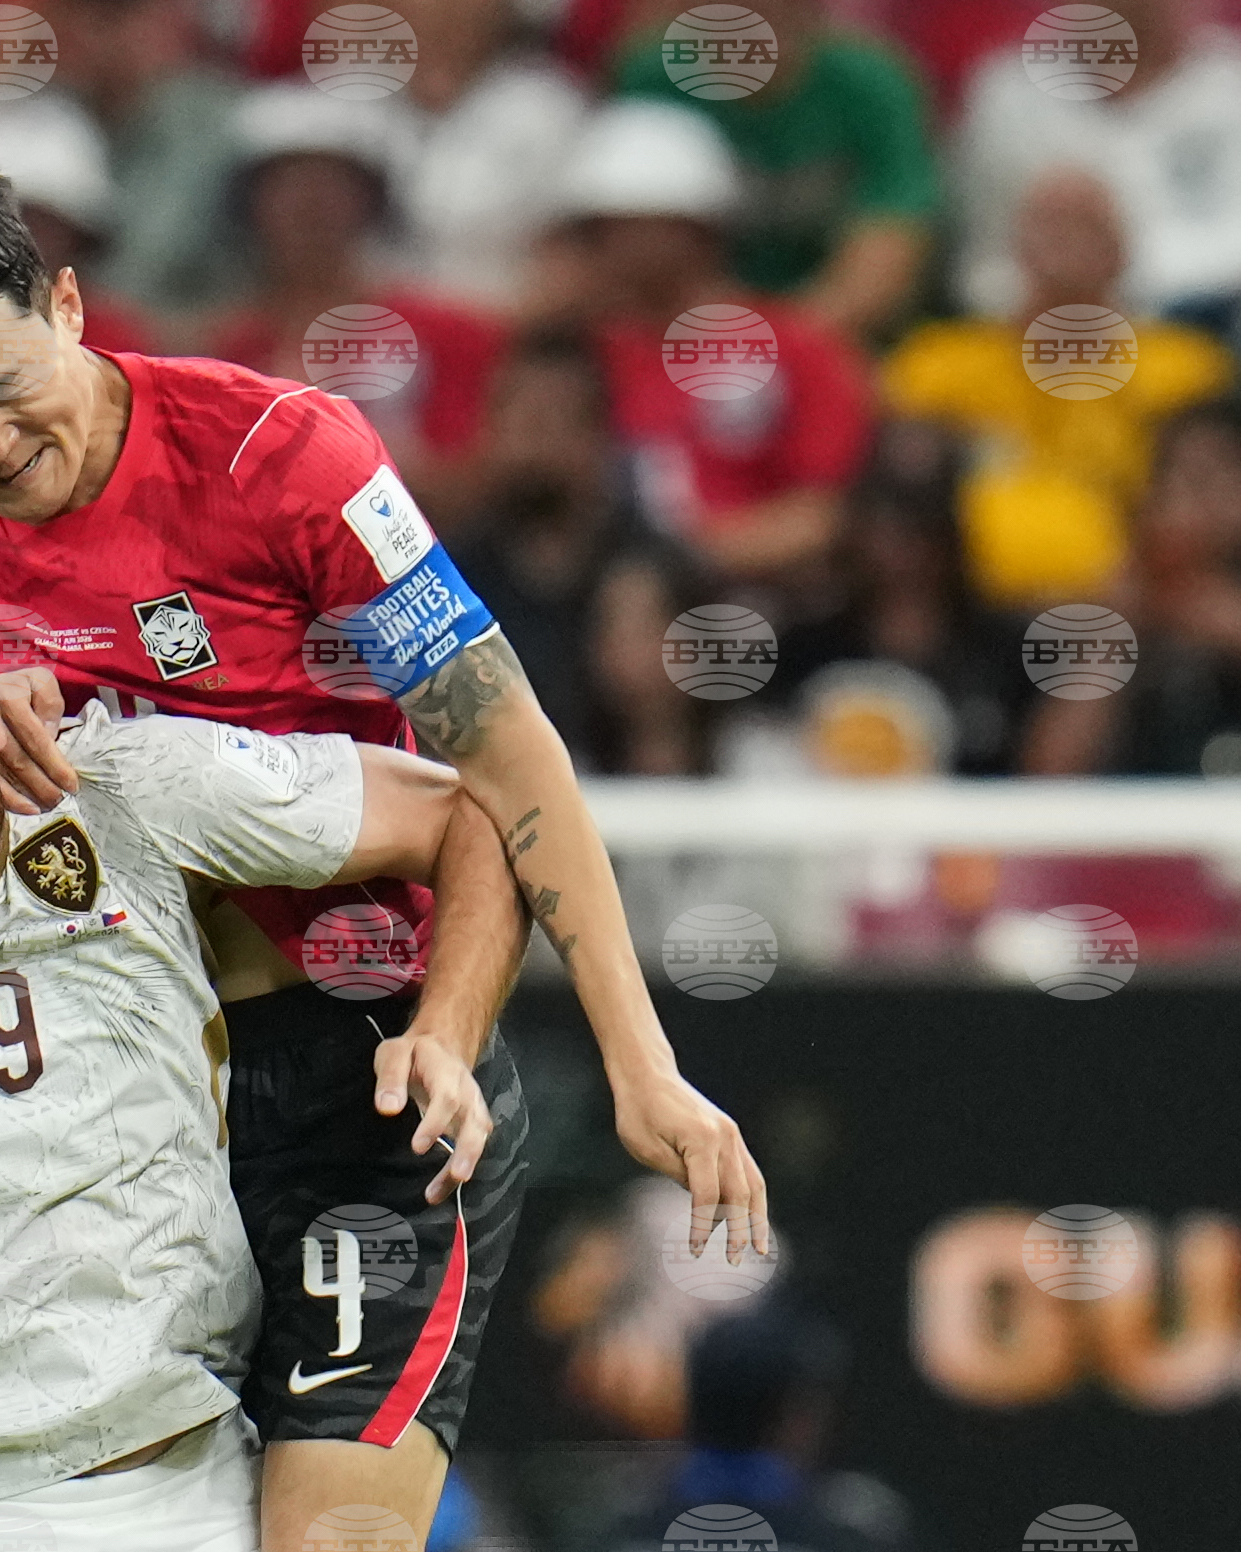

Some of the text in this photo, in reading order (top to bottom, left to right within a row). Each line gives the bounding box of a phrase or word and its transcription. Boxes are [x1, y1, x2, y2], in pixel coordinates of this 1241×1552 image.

[392, 523, 419, 554] PEACE
[404, 543, 419, 559] FIFA
[367, 564, 437, 627] FOOTBALL
[379, 578, 450, 646] UNITES
[391, 594, 467, 667] the World
[428, 636, 455, 662] FIFA
[301, 1229, 366, 1357] 4
